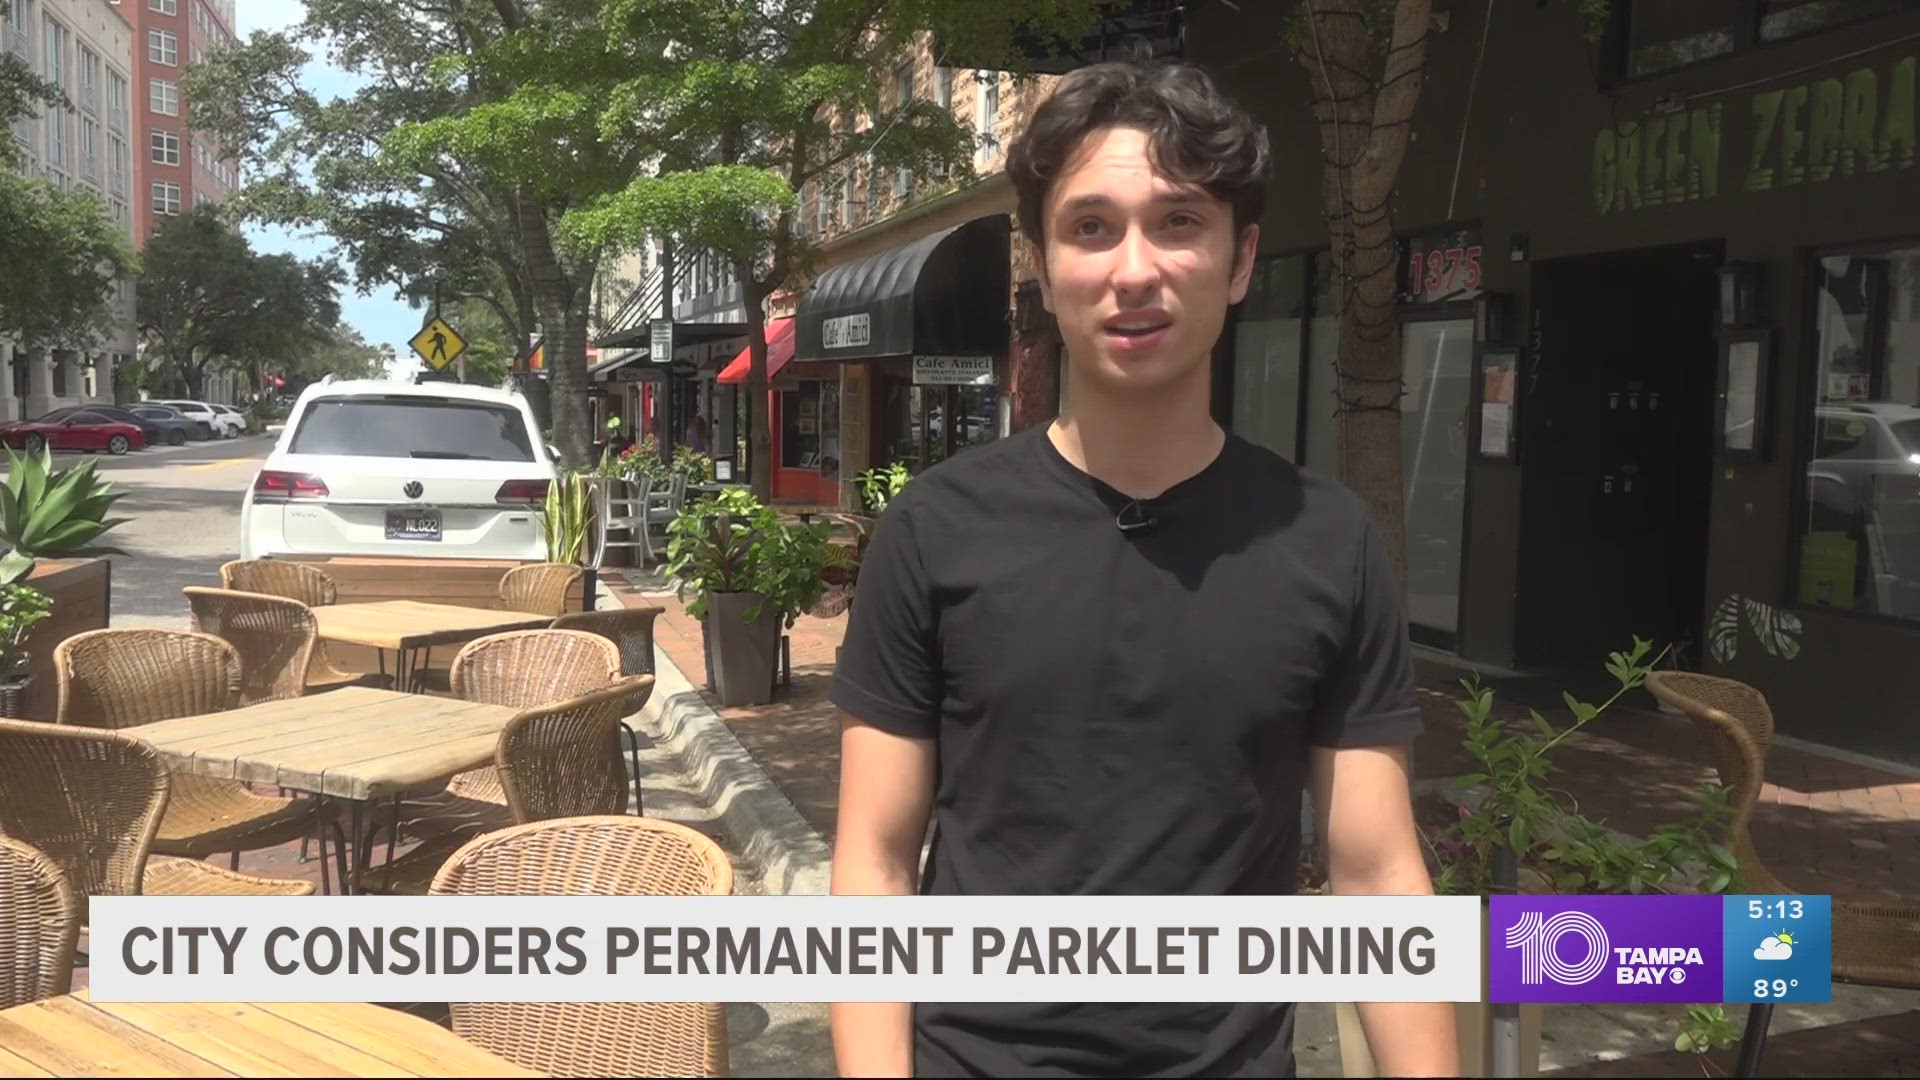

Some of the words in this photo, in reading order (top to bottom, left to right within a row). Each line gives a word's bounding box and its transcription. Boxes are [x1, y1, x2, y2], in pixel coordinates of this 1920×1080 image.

[1592, 102, 1722, 216] GREEN
[1743, 56, 1917, 192] ZEBRA
[1411, 246, 1482, 295] 1375
[846, 317, 868, 344] Amici
[916, 358, 945, 369] Cafe
[951, 358, 989, 369] Amici
